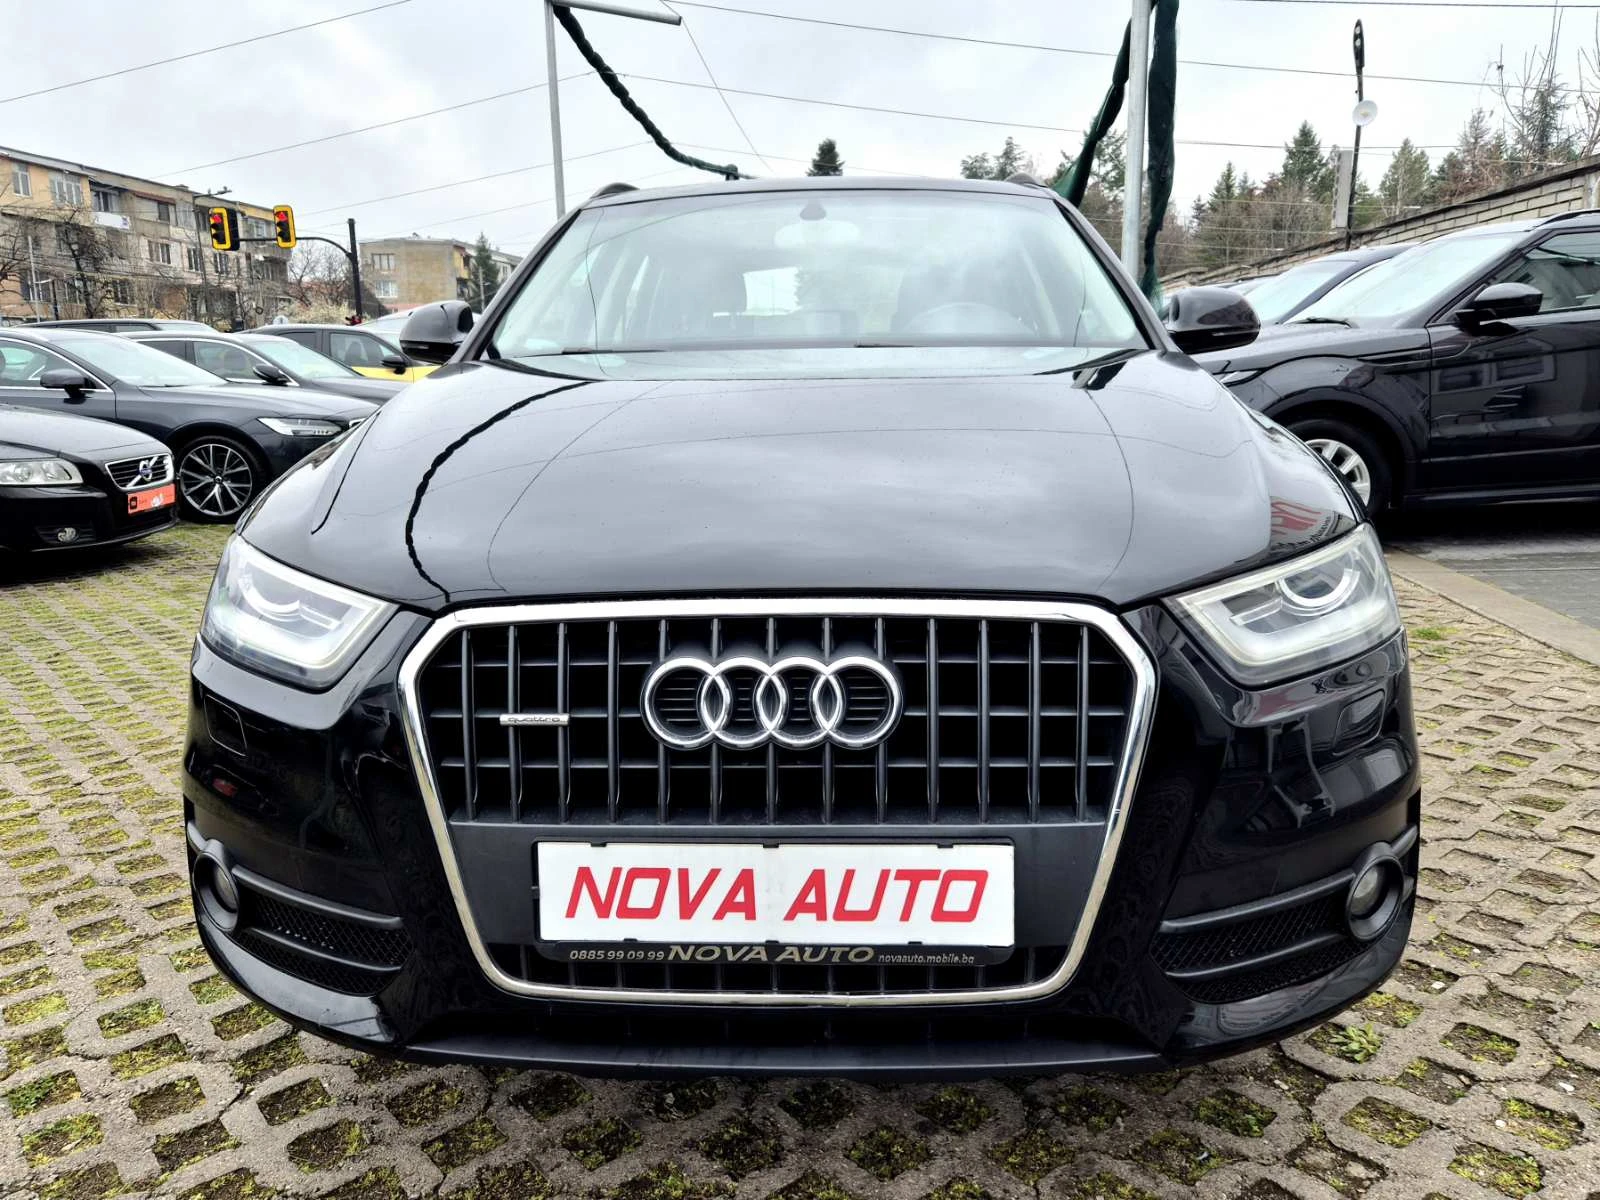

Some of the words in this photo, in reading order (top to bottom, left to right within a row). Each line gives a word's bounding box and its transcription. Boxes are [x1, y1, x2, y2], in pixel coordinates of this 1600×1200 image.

[565, 866, 757, 920] NOVA
[784, 868, 989, 922] AUTO
[569, 950, 605, 960] 0885
[607, 950, 625, 960] 99
[627, 951, 645, 960] 09
[647, 951, 665, 961] 99
[667, 945, 769, 961] NOVA
[775, 946, 875, 963] AUTO
